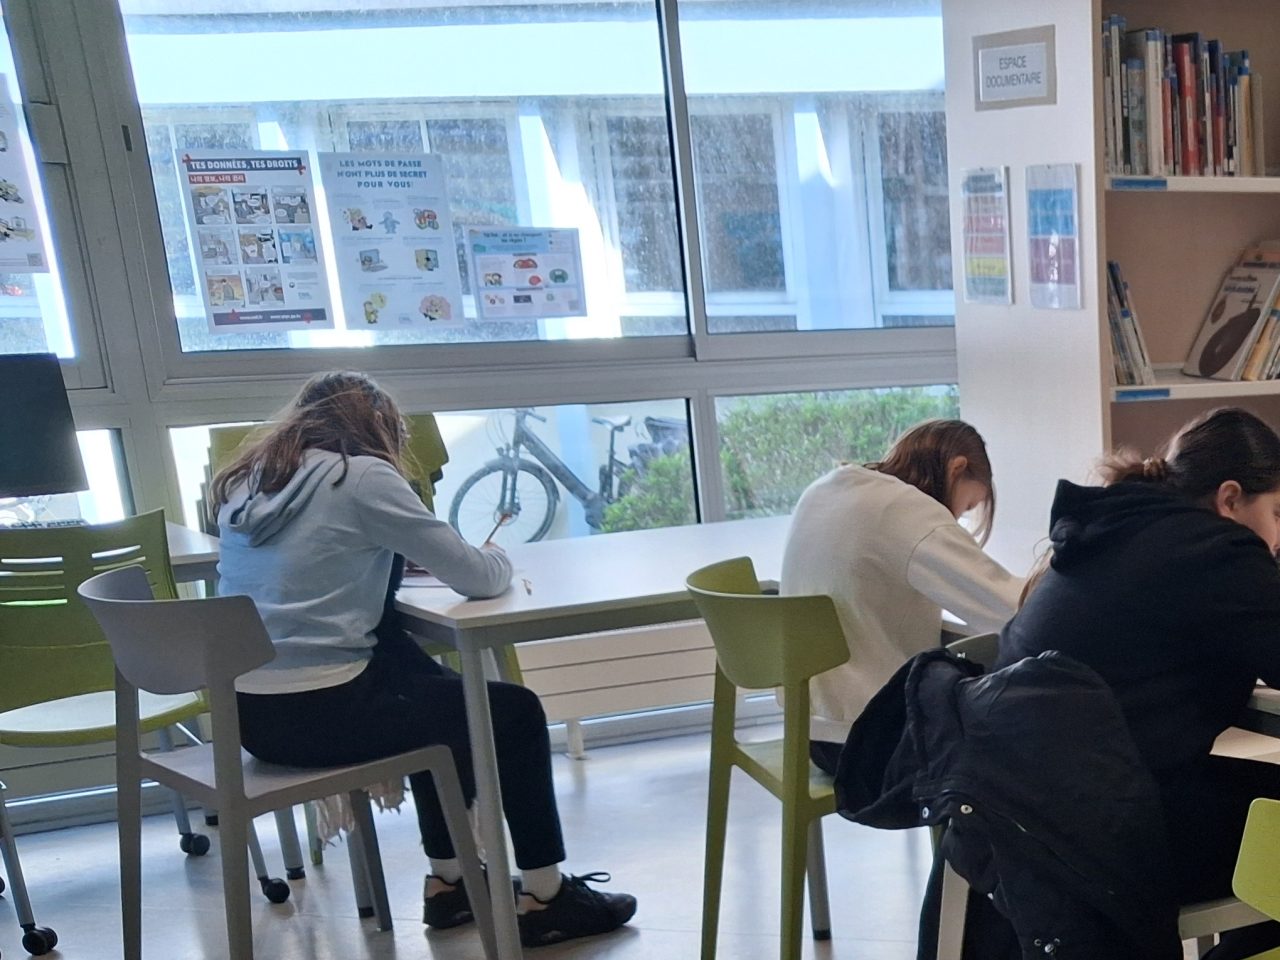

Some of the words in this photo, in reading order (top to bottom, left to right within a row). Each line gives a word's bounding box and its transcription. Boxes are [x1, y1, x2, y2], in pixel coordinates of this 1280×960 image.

[999, 55, 1027, 70] ESPACE
[985, 72, 1042, 88] DOCUMENTAIRE
[191, 161, 206, 170] TES
[251, 160, 267, 168] TES
[267, 160, 298, 168] DROITS
[398, 160, 422, 168] PASSE
